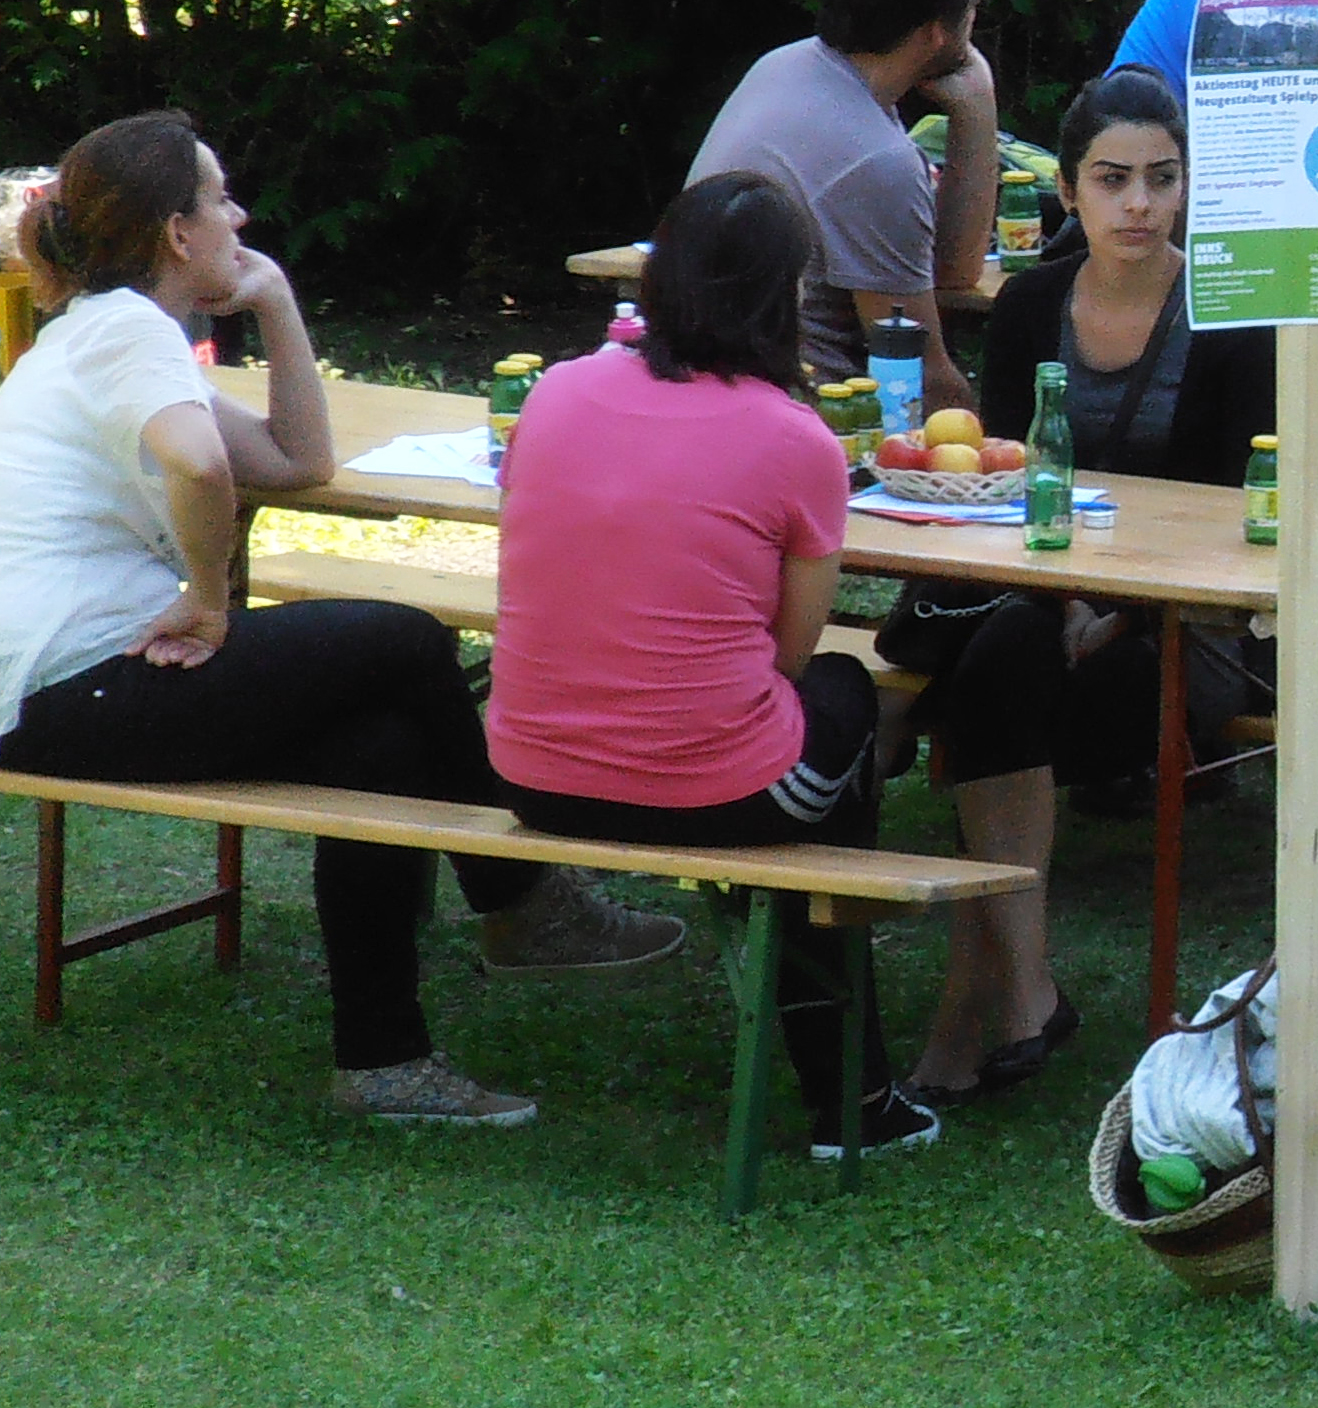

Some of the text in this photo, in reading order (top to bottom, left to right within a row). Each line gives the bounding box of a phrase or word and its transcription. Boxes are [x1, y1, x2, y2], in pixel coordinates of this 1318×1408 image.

[1194, 76, 1259, 91] Aktionstag
[1262, 75, 1300, 87] HEUTE
[1194, 92, 1278, 108] Neugestaltung
